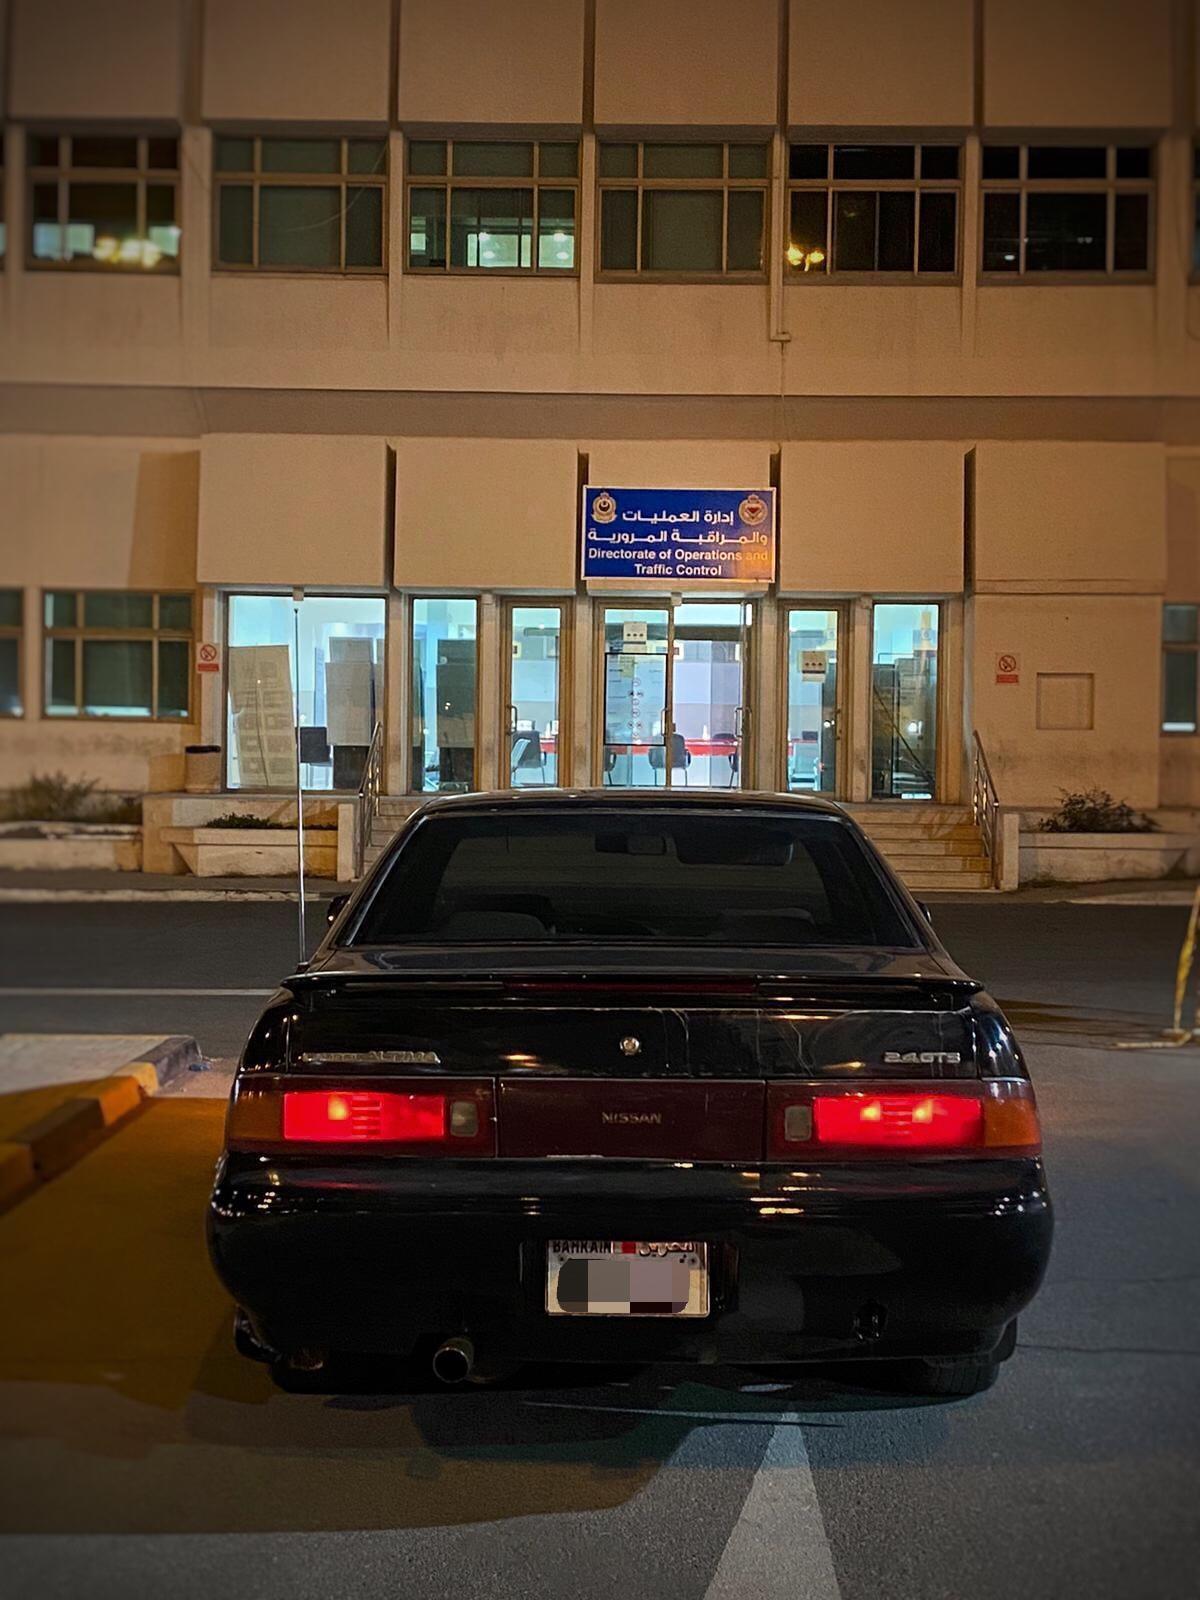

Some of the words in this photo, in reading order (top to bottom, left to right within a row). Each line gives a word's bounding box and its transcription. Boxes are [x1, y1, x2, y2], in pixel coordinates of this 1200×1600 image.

[622, 510, 700, 524] العمليات
[703, 510, 734, 526] إدارة
[588, 528, 667, 543] المرورية
[671, 528, 768, 545] والمراقبة
[588, 548, 656, 560] Directorate
[659, 548, 672, 560] of
[675, 548, 742, 562] Operations
[746, 550, 768, 561] and
[634, 563, 673, 575] Traffic
[676, 564, 722, 576] Control
[602, 1111, 662, 1124] NISSAN
[552, 1240, 610, 1253] BAHRAIN
